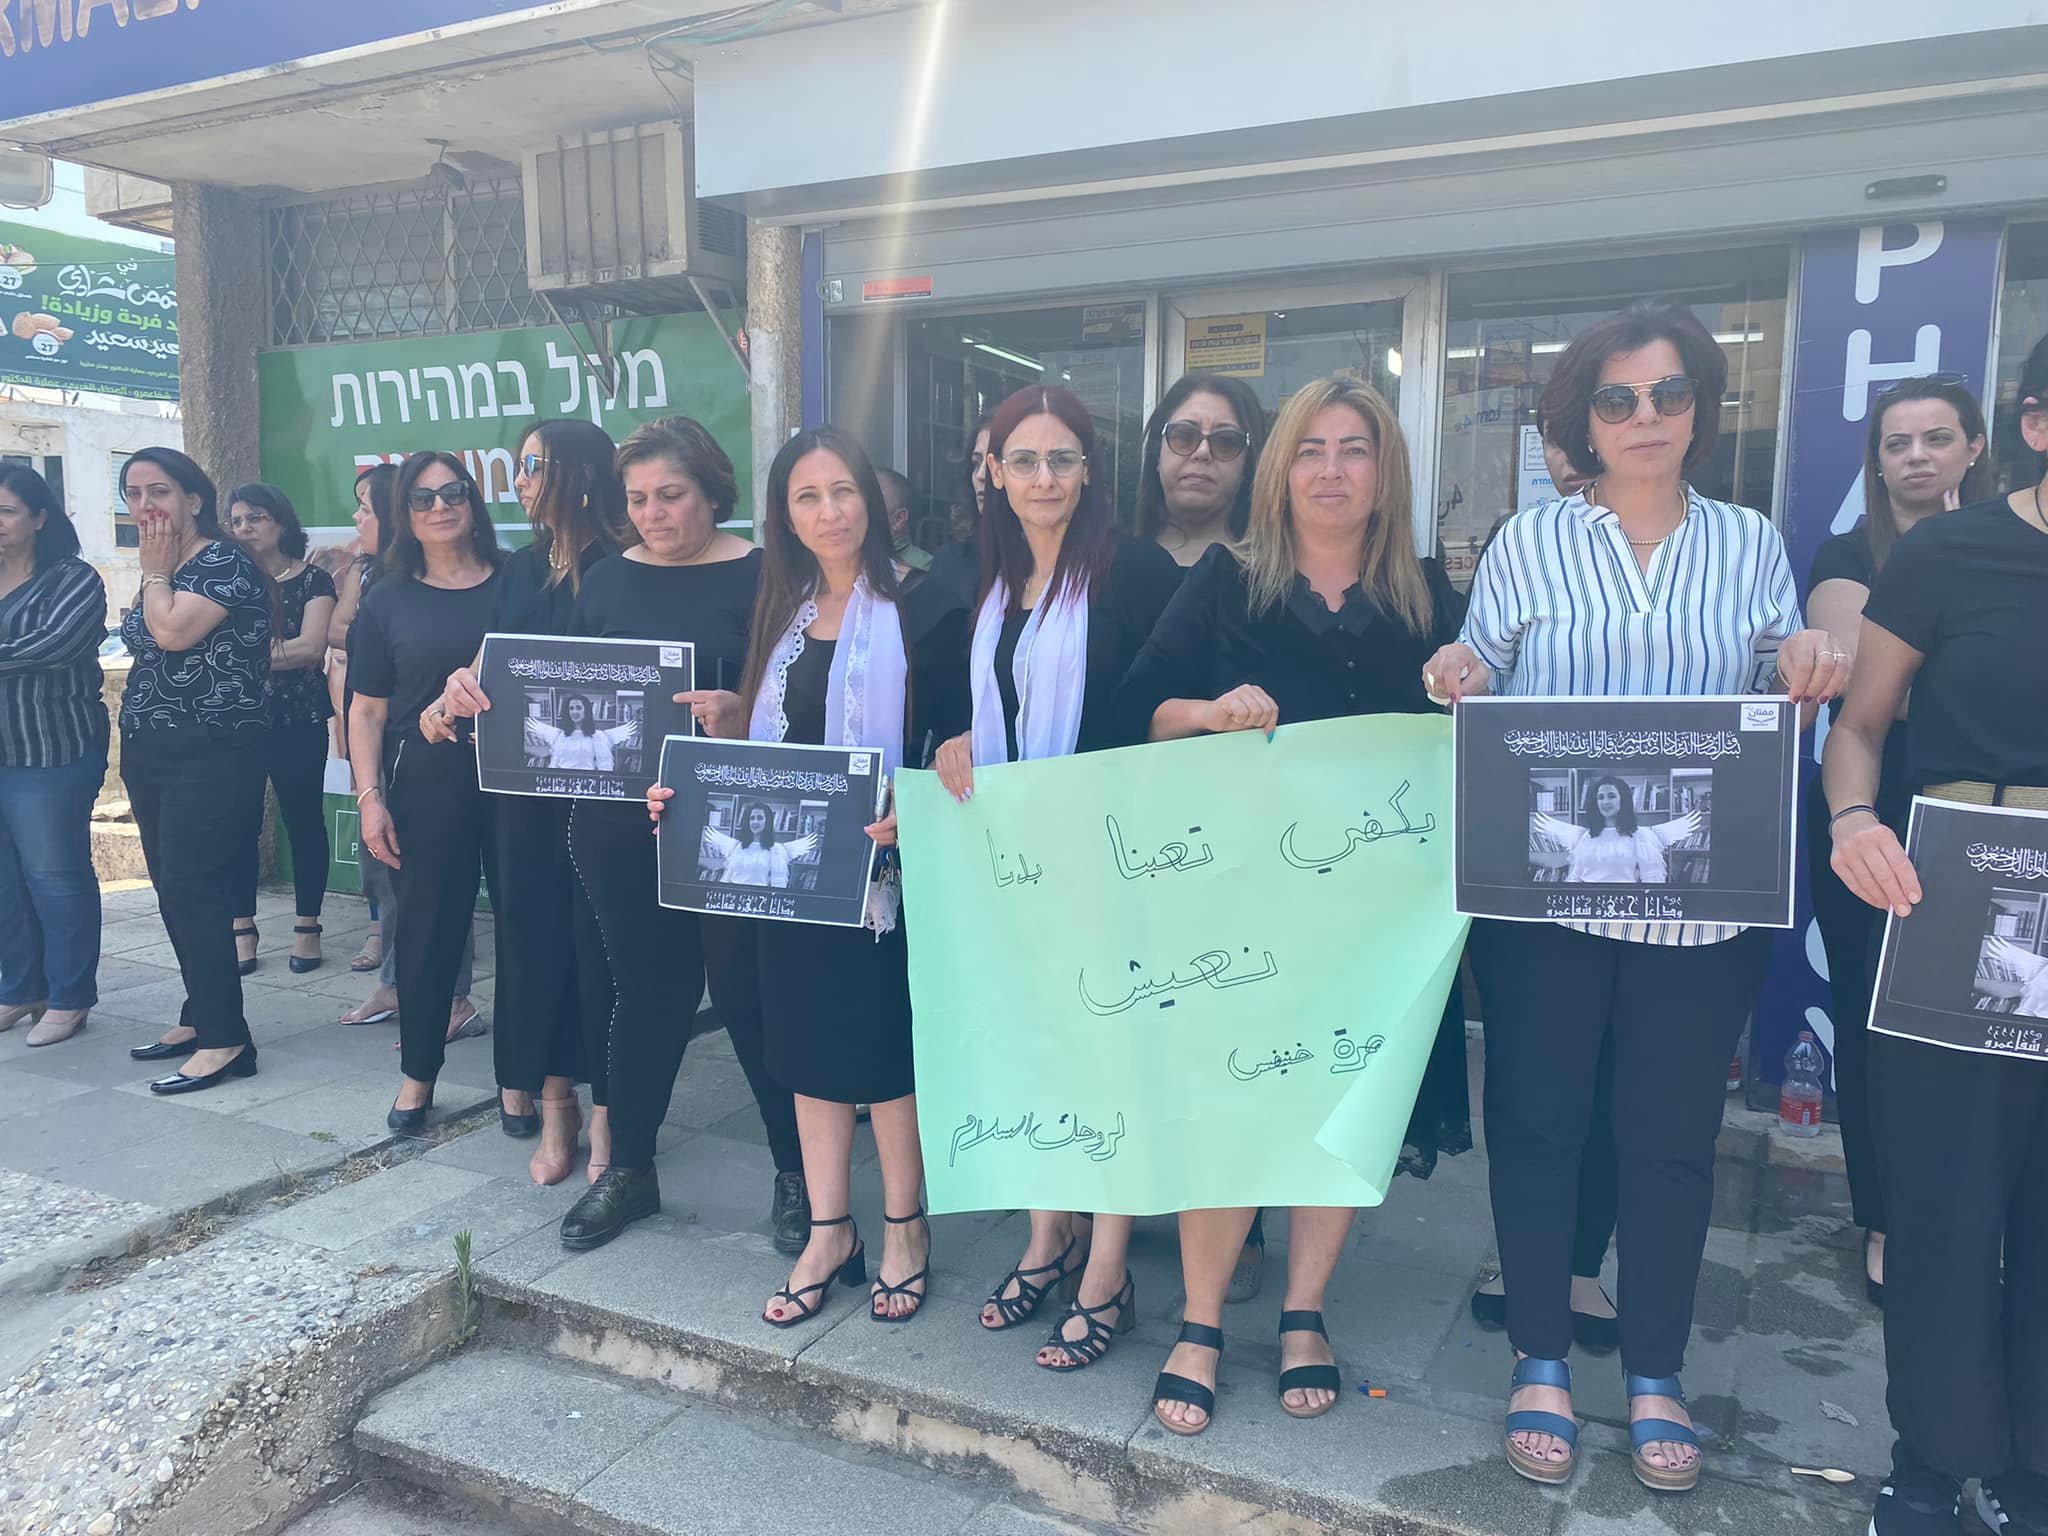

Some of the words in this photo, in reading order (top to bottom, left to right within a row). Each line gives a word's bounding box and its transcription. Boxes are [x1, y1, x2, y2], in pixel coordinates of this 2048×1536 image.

[331, 358, 535, 428] במהירות
[545, 341, 668, 430] מקל
[1106, 814, 1214, 880] تعبنا
[1280, 779, 1435, 874] بكفي
[1078, 946, 1279, 1016] نعيش
[949, 1111, 1035, 1168] السلام
[1029, 1112, 1125, 1162] لروحك
